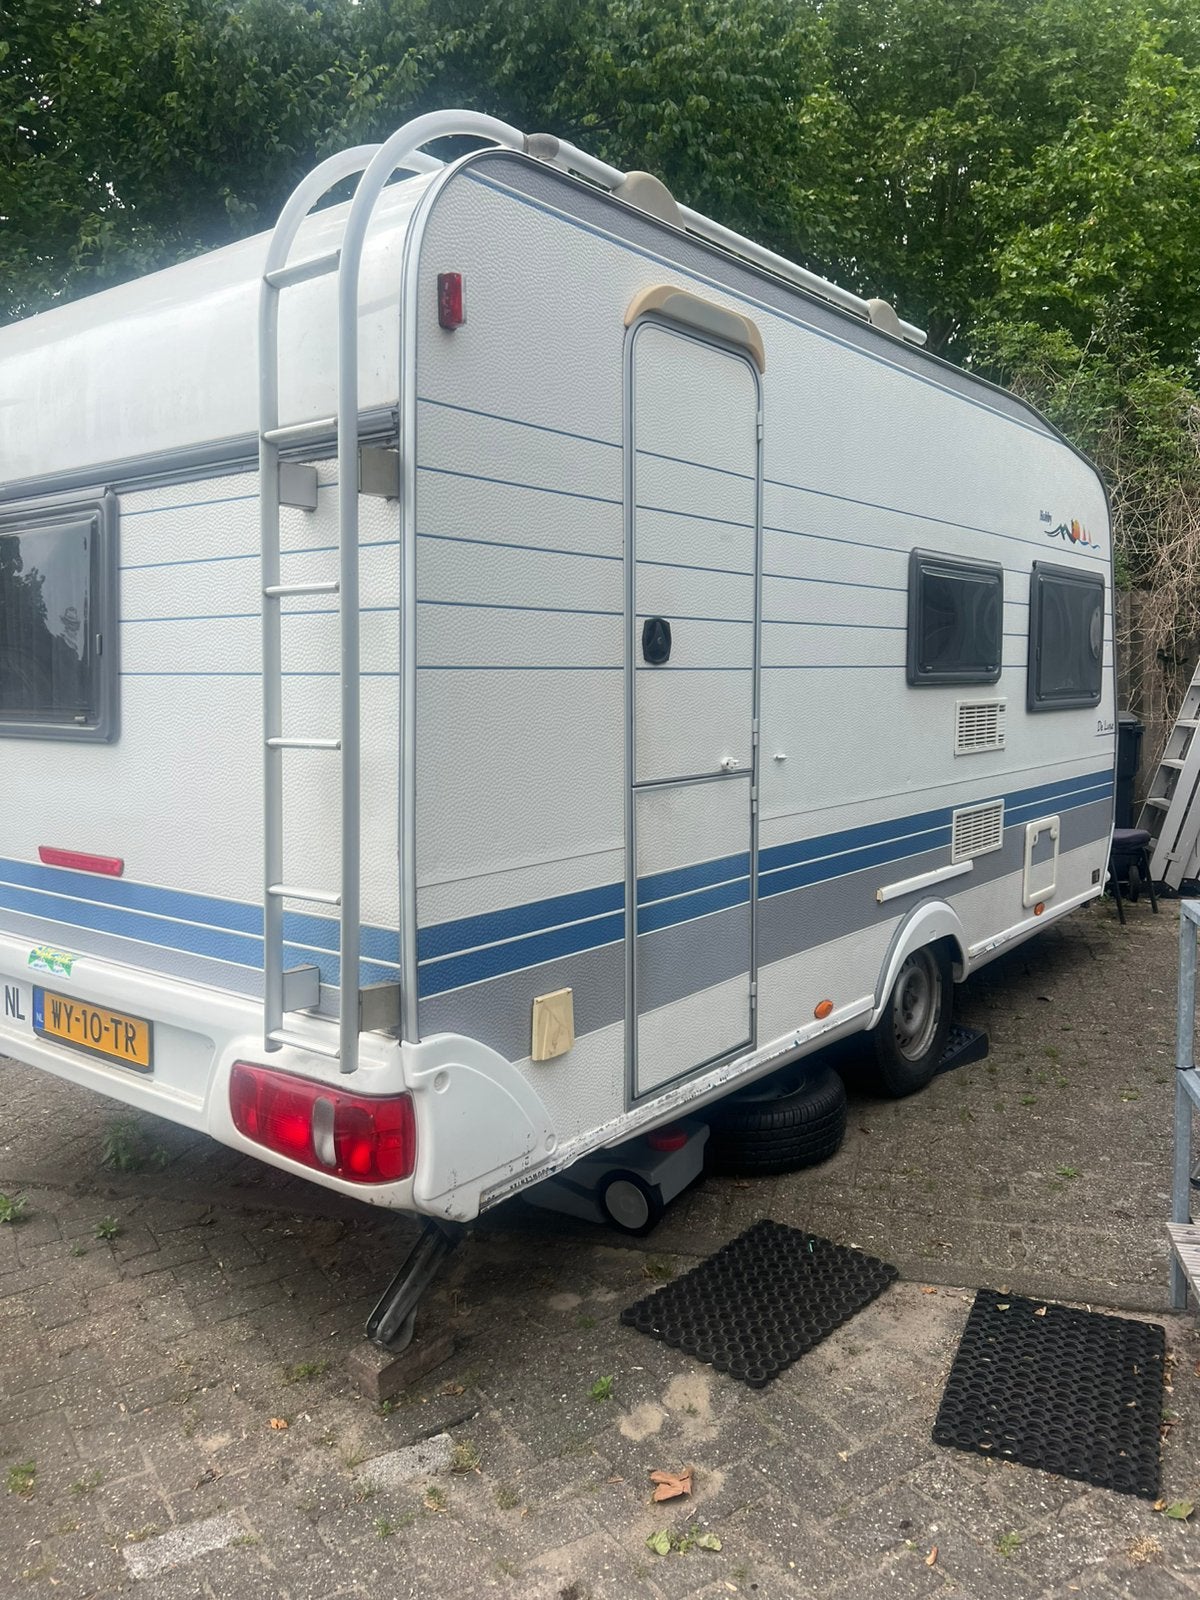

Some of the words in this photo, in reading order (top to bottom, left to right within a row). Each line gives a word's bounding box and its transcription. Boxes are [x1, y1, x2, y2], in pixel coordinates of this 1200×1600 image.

[5, 985, 25, 1020] NL
[36, 1012, 43, 1023] NL
[52, 999, 137, 1056] WY-10-TR
